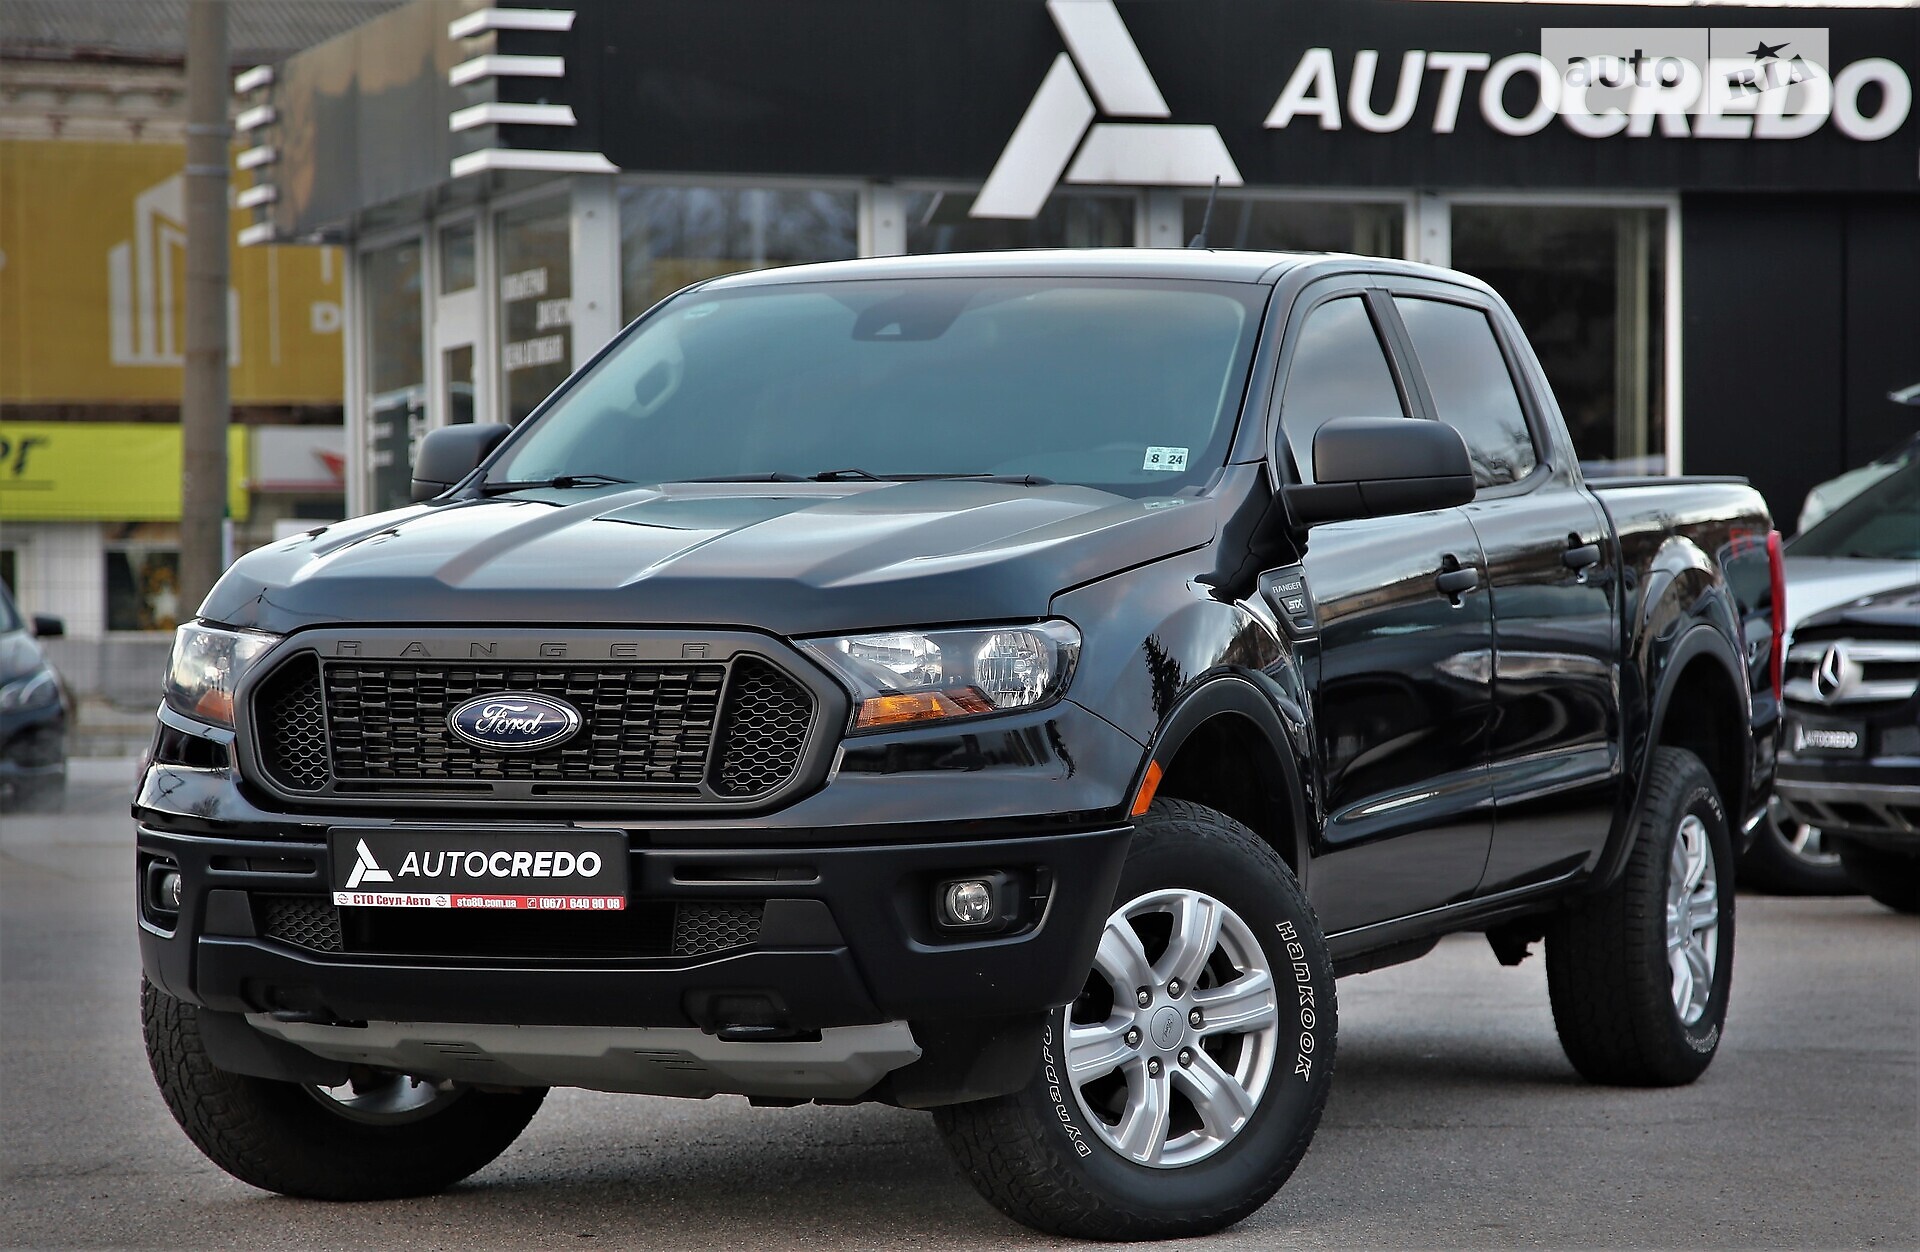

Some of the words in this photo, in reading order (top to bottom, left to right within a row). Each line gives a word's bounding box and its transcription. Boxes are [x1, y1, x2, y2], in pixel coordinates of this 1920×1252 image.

[1263, 47, 1912, 141] AUTOCREDO
[1151, 453, 1160, 464] 8
[1168, 455, 1183, 465] 24
[1272, 581, 1302, 594] RANGER
[1288, 598, 1304, 610] STX
[336, 640, 710, 659] RANGER
[475, 703, 544, 736] Ford
[397, 851, 602, 878] AUTOCREDO
[353, 894, 374, 905] СТО
[376, 894, 431, 906] Сеул-Авто
